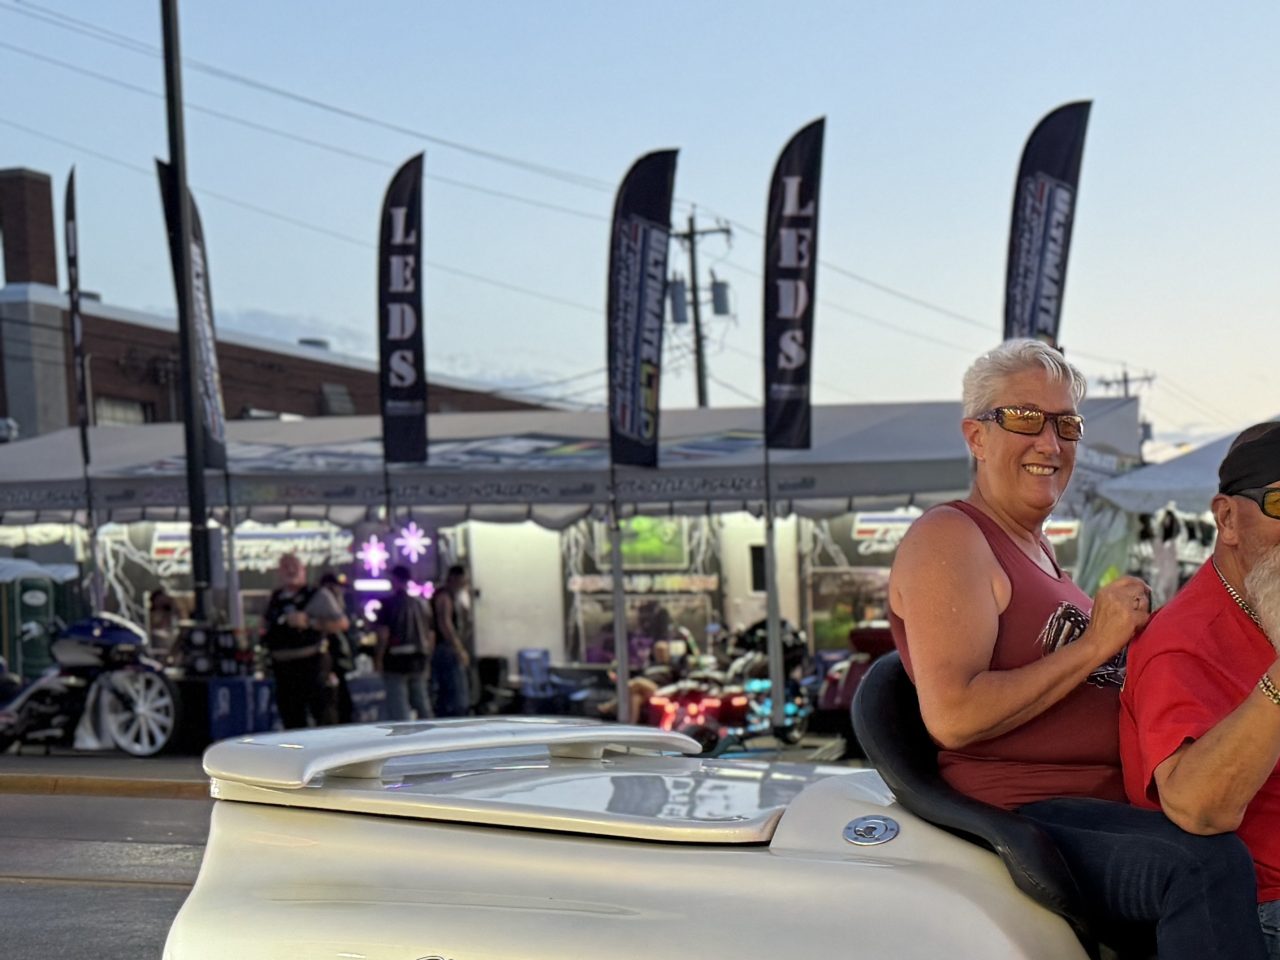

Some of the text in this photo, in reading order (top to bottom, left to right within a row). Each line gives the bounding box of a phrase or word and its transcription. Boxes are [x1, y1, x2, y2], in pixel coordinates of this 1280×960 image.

[386, 206, 417, 388] LEDS
[639, 226, 669, 441] ULTIMATE LED
[776, 176, 815, 370] LEDS
[1038, 185, 1072, 335] ULTIMATE
